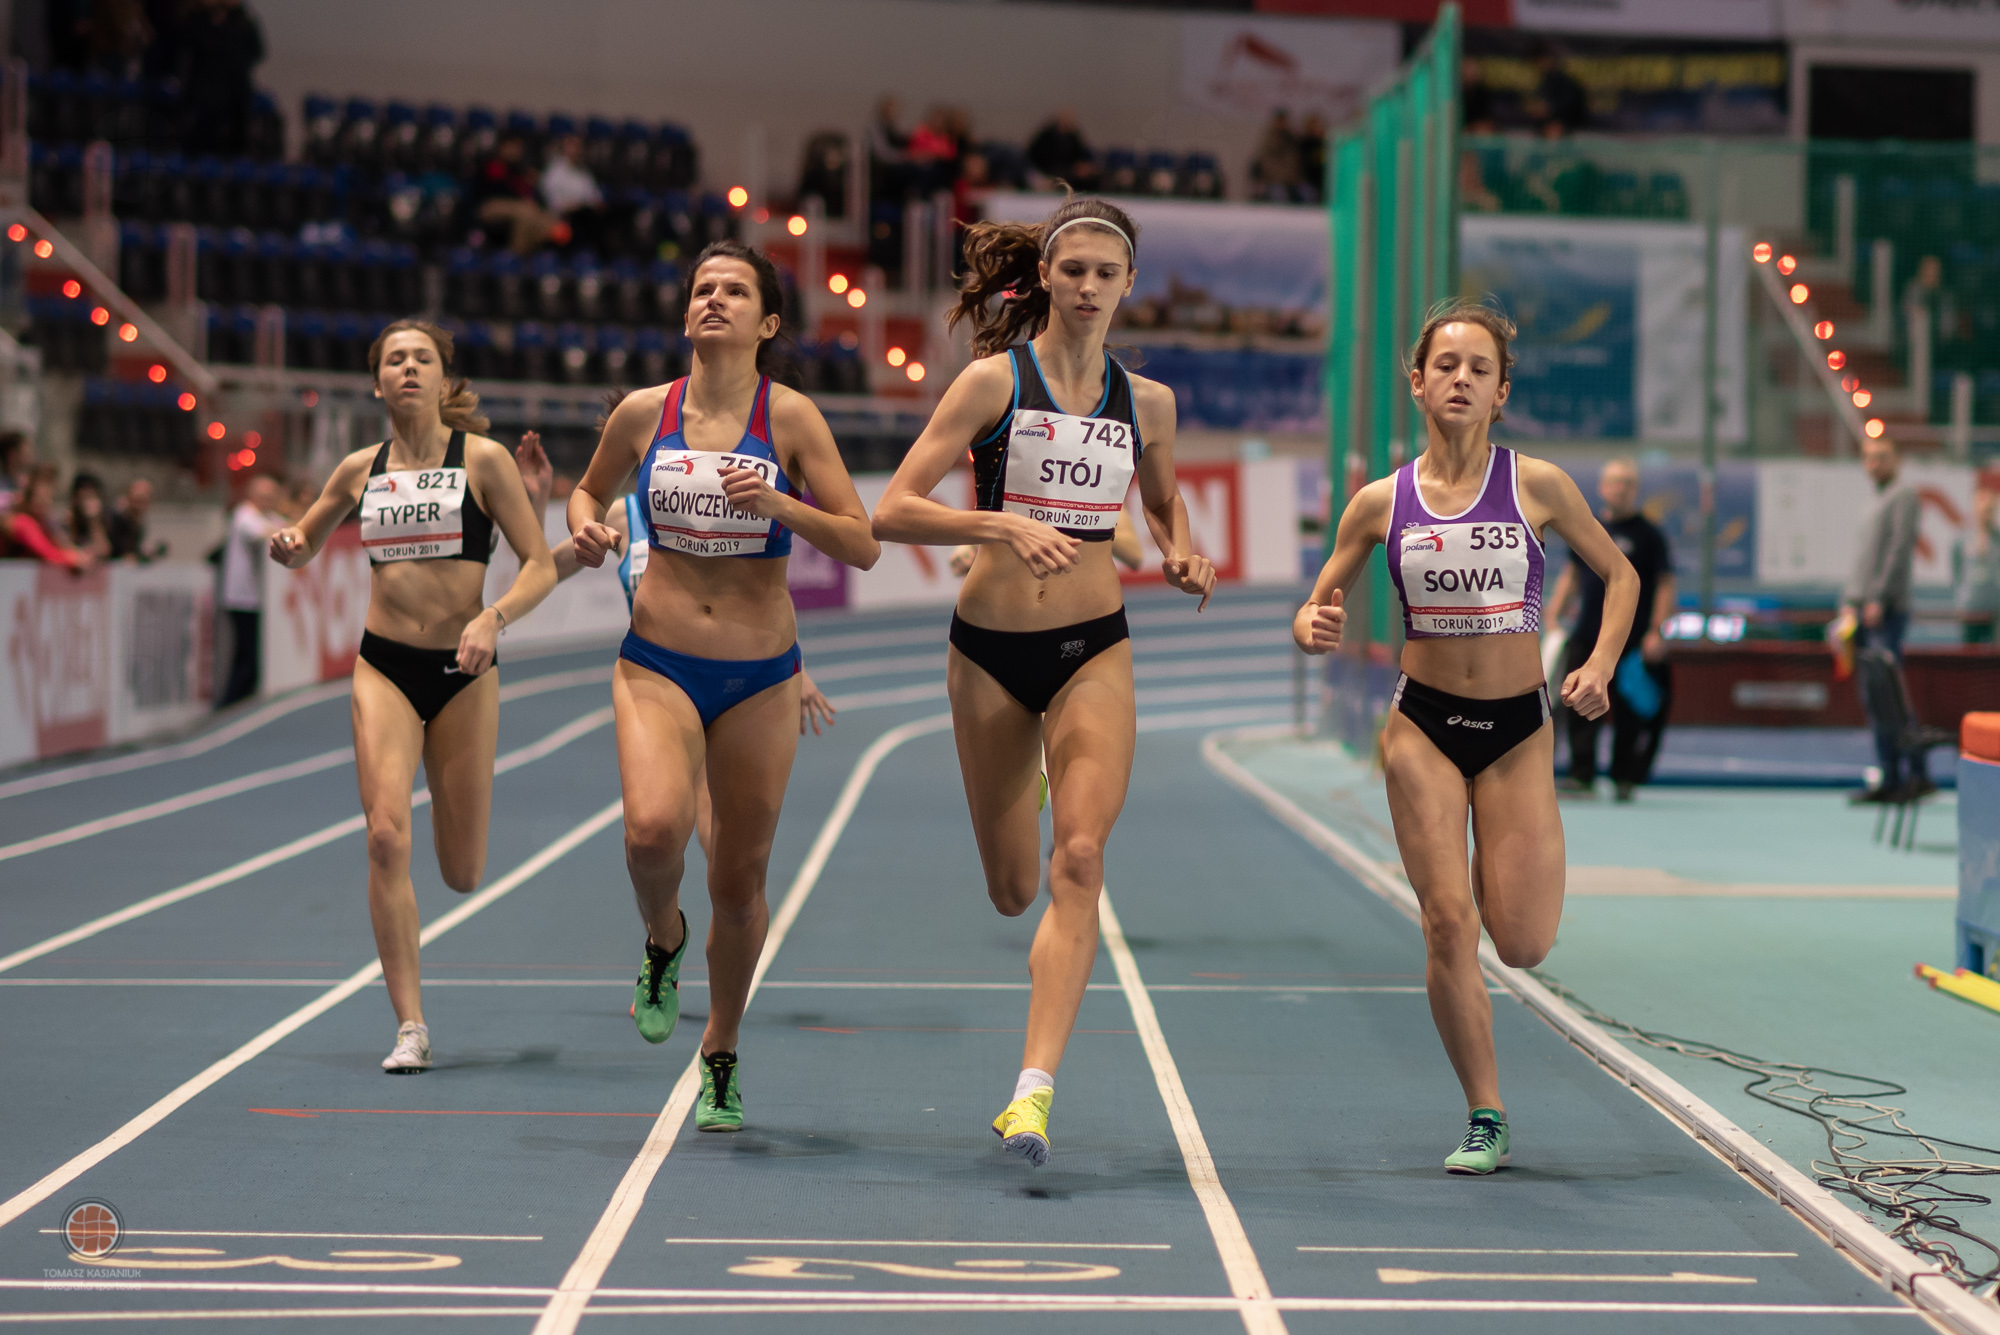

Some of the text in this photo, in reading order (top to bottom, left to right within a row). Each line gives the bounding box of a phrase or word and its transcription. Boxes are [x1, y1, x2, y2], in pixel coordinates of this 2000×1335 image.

[1014, 428, 1048, 438] polanik
[1080, 421, 1127, 449] 742
[655, 464, 685, 473] polanik
[1039, 457, 1102, 488] STÓJ
[416, 471, 458, 490] 821
[652, 486, 766, 521] GŁÓWCZEW
[377, 502, 441, 526] TYPER
[1029, 510, 1100, 526] TORUŃ 2019
[675, 536, 740, 553] TORUŃ 2019
[1469, 526, 1519, 550] 535
[382, 544, 440, 558] TORUŃ 2019
[1405, 543, 1435, 552] polanik
[1424, 567, 1504, 592] SOWA
[1432, 616, 1504, 630] TORUŃ 2019
